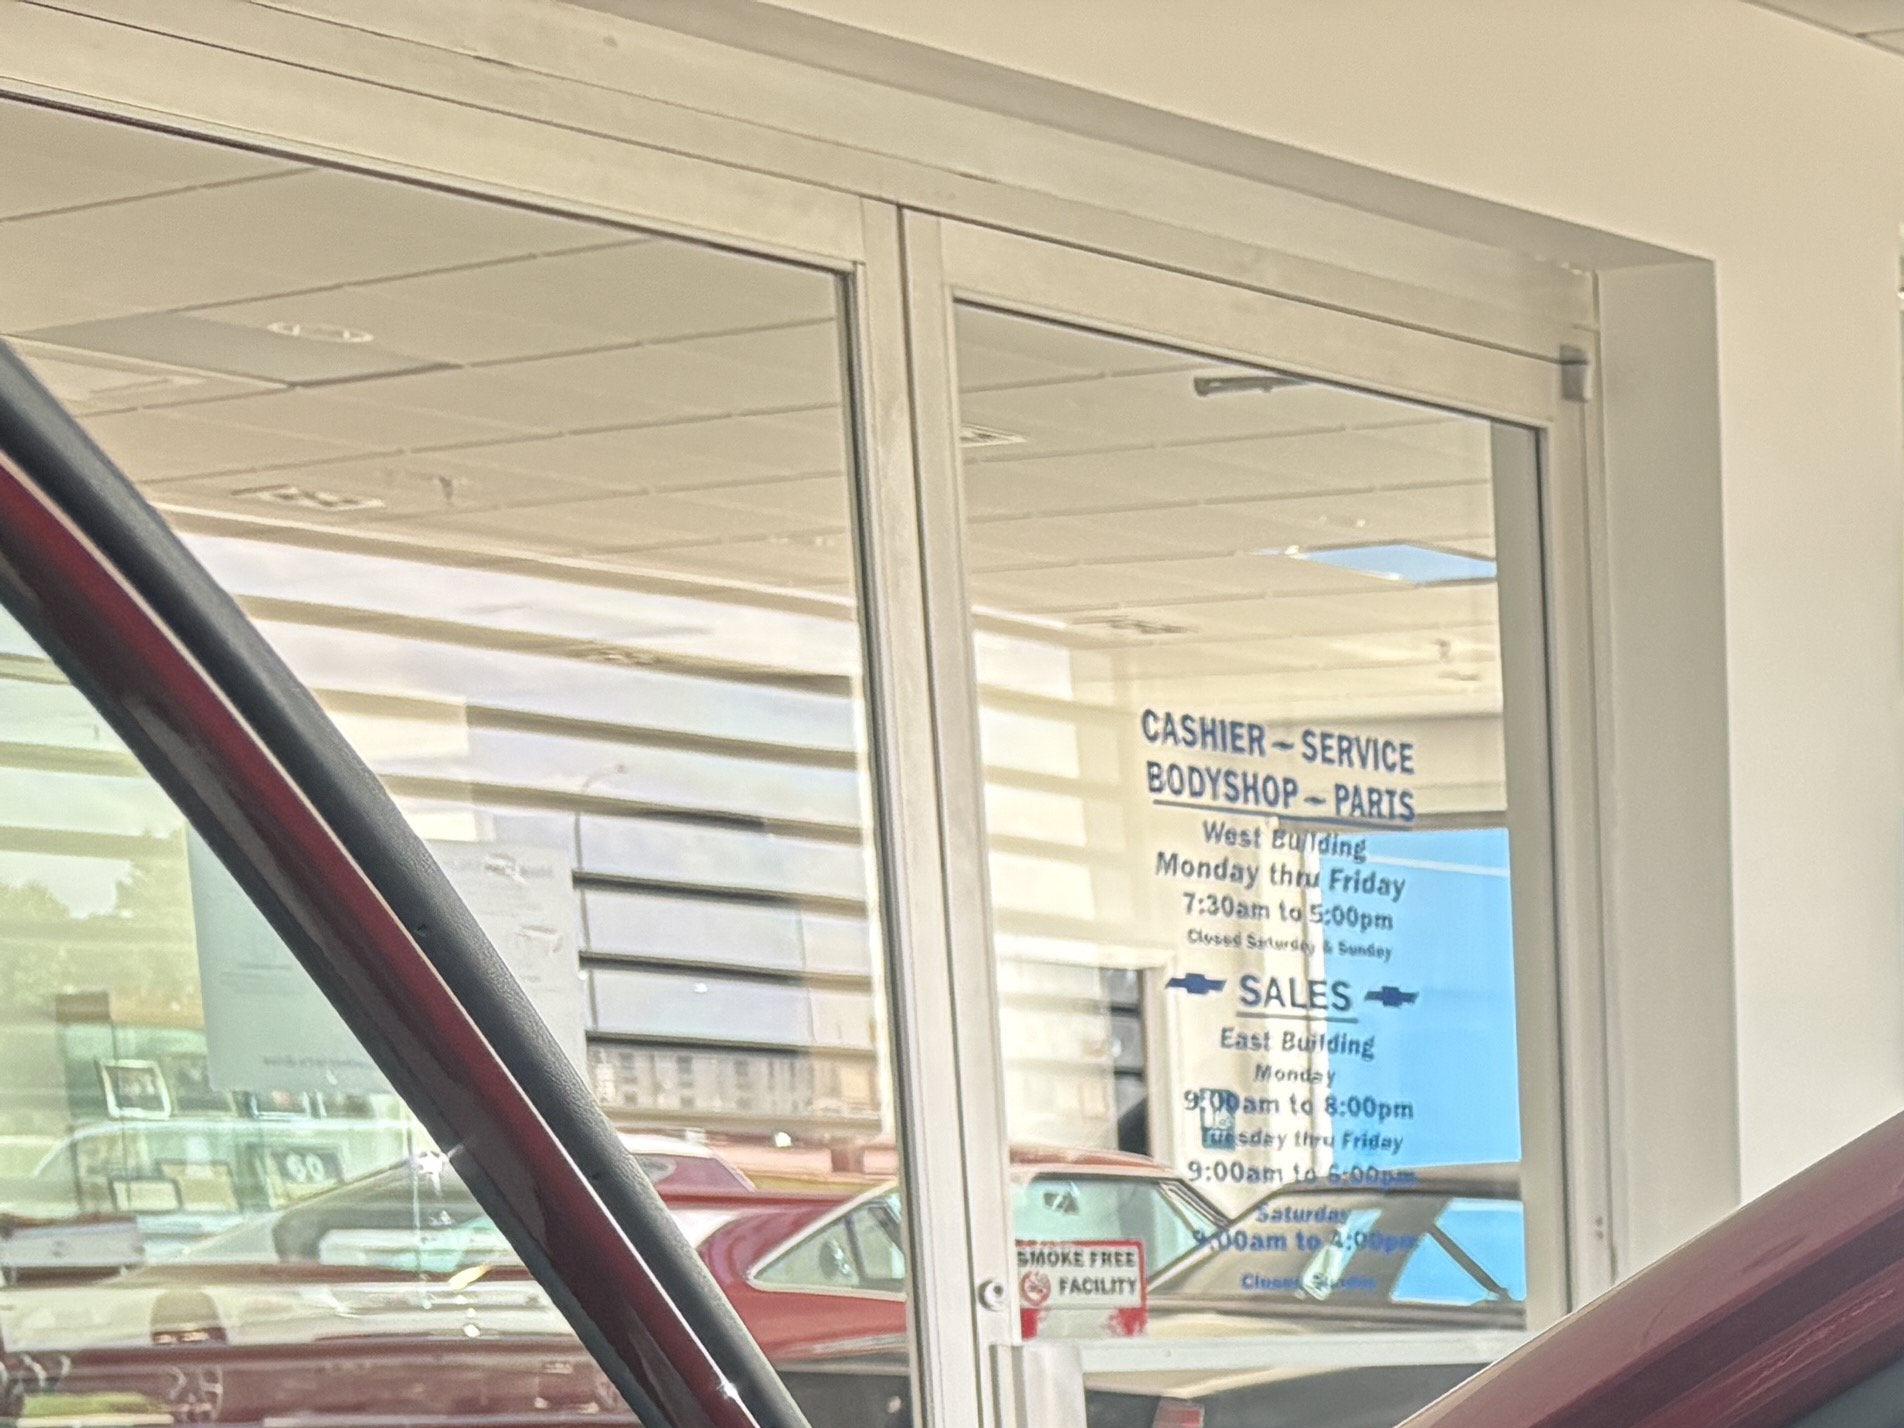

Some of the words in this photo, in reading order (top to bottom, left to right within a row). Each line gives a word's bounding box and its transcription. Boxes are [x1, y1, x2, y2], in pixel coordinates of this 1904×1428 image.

[1141, 708, 1266, 757] CASHIER
[1301, 728, 1415, 775] SERVICE
[1146, 760, 1298, 809] BODYSHOP
[1334, 783, 1416, 822] PARTS
[1202, 819, 1262, 849] West
[1156, 851, 1259, 890] Monday
[1270, 862, 1320, 888] thru
[1329, 867, 1406, 902] Friday
[1182, 892, 1270, 920] 7:30am
[1279, 902, 1301, 922] to
[1310, 904, 1393, 933] 5:00pm
[1239, 974, 1352, 1012] SALES
[1220, 1027, 1270, 1050] East
[1282, 1030, 1375, 1062] Building
[1254, 1063, 1336, 1087] Monday
[1290, 1094, 1314, 1116] to
[1295, 1130, 1335, 1147] thru
[1342, 1130, 1404, 1156] Friday
[1188, 1161, 1283, 1184] 9:00am
[1293, 1163, 1317, 1184] to
[1295, 1232, 1321, 1250] to
[1017, 1249, 1084, 1268] SMOKE
[1089, 1251, 1136, 1268] FREE
[1059, 1276, 1137, 1296] FACILITY
